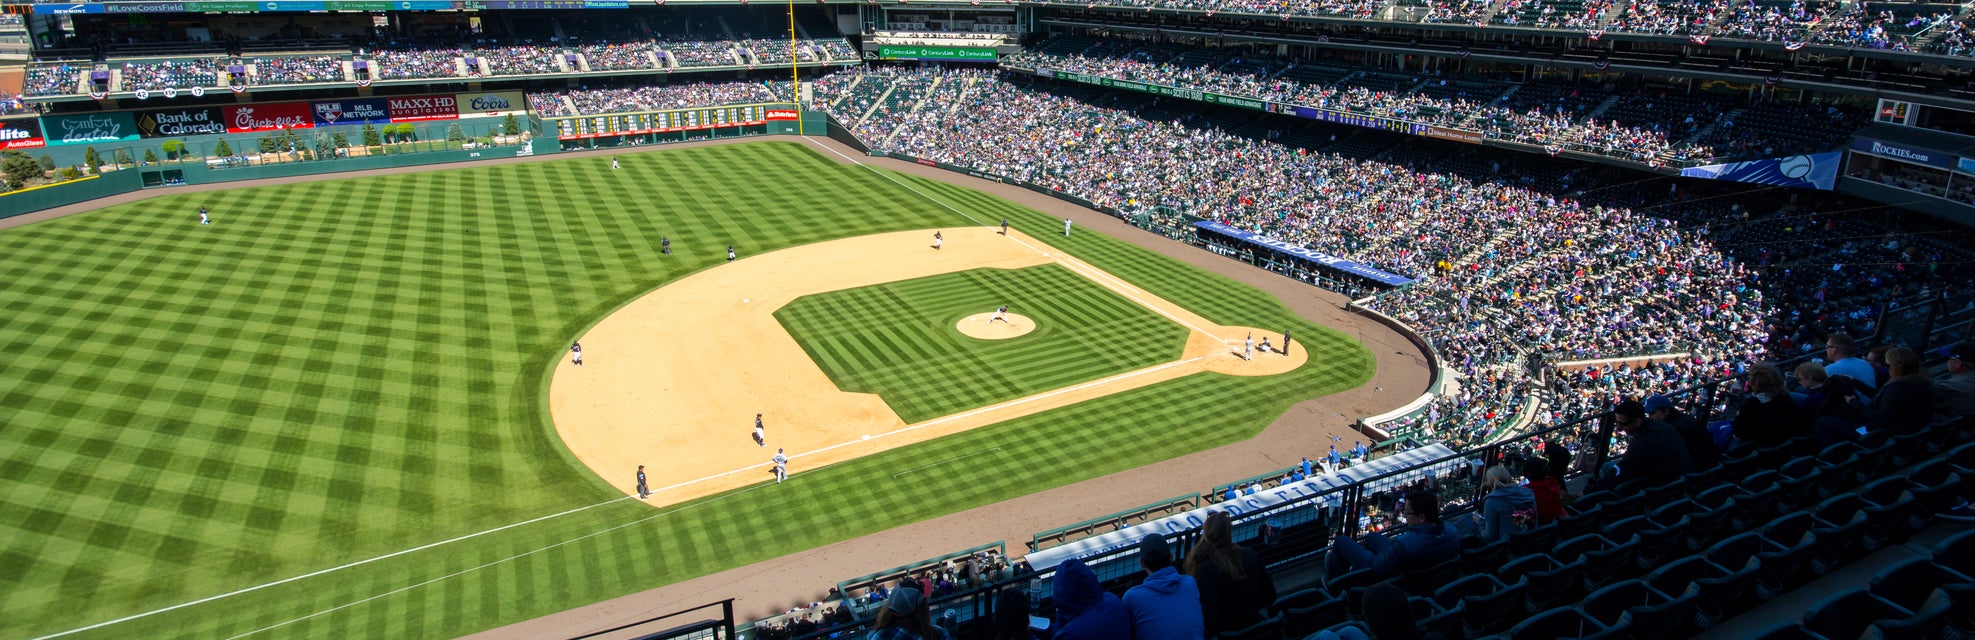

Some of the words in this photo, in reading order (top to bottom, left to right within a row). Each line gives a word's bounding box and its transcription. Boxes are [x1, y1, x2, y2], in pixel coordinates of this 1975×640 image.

[108, 4, 183, 12] #ILoveCoorsField
[390, 99, 432, 110] MAXX
[434, 97, 455, 107] HD
[470, 97, 511, 110] Coors
[156, 111, 193, 124] Bank
[194, 109, 208, 121] of
[343, 110, 385, 118] NETWORK
[391, 107, 456, 115] sunglasses
[61, 115, 113, 130] Comfort
[236, 108, 306, 130] Chick-fil-A
[62, 124, 120, 142] dental
[160, 120, 225, 134] Colorado
[1447, 131, 1464, 139] Home
[1872, 142, 1929, 161] ROCKIES.com
[1246, 235, 1341, 265] ROCKIES
[1165, 498, 1262, 534] CORS
